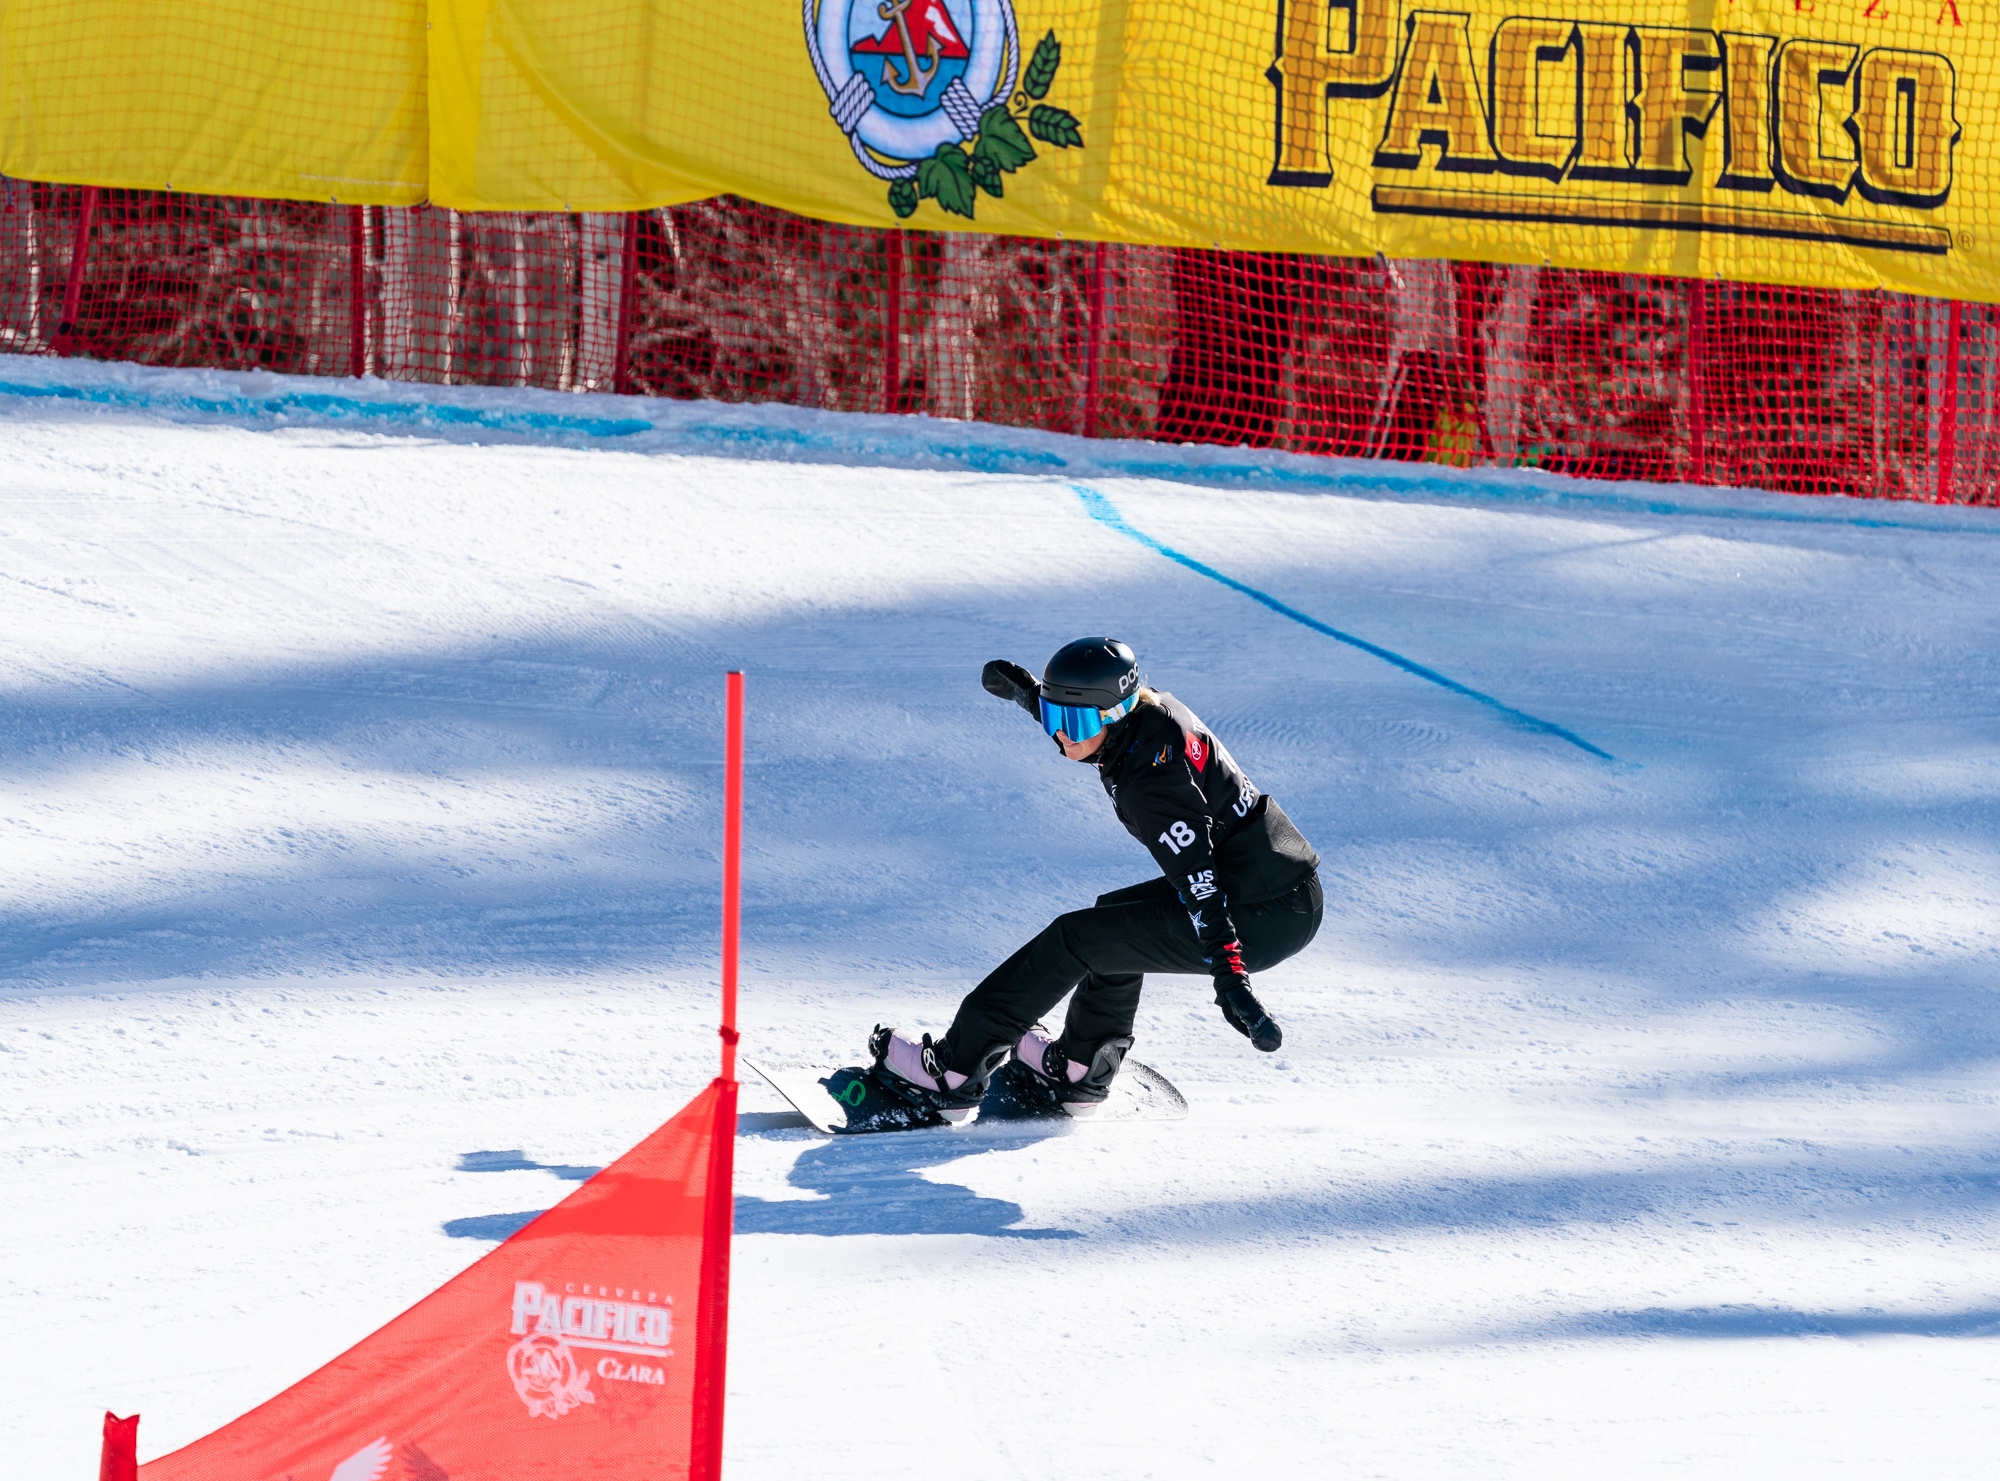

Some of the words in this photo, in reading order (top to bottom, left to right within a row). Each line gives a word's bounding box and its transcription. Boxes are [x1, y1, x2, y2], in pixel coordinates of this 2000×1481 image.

[1266, 0, 1962, 207] PACIFICO
[1158, 820, 1196, 855] 18
[510, 1281, 673, 1347] PACIFICO
[565, 1282, 674, 1306] CERVEZA
